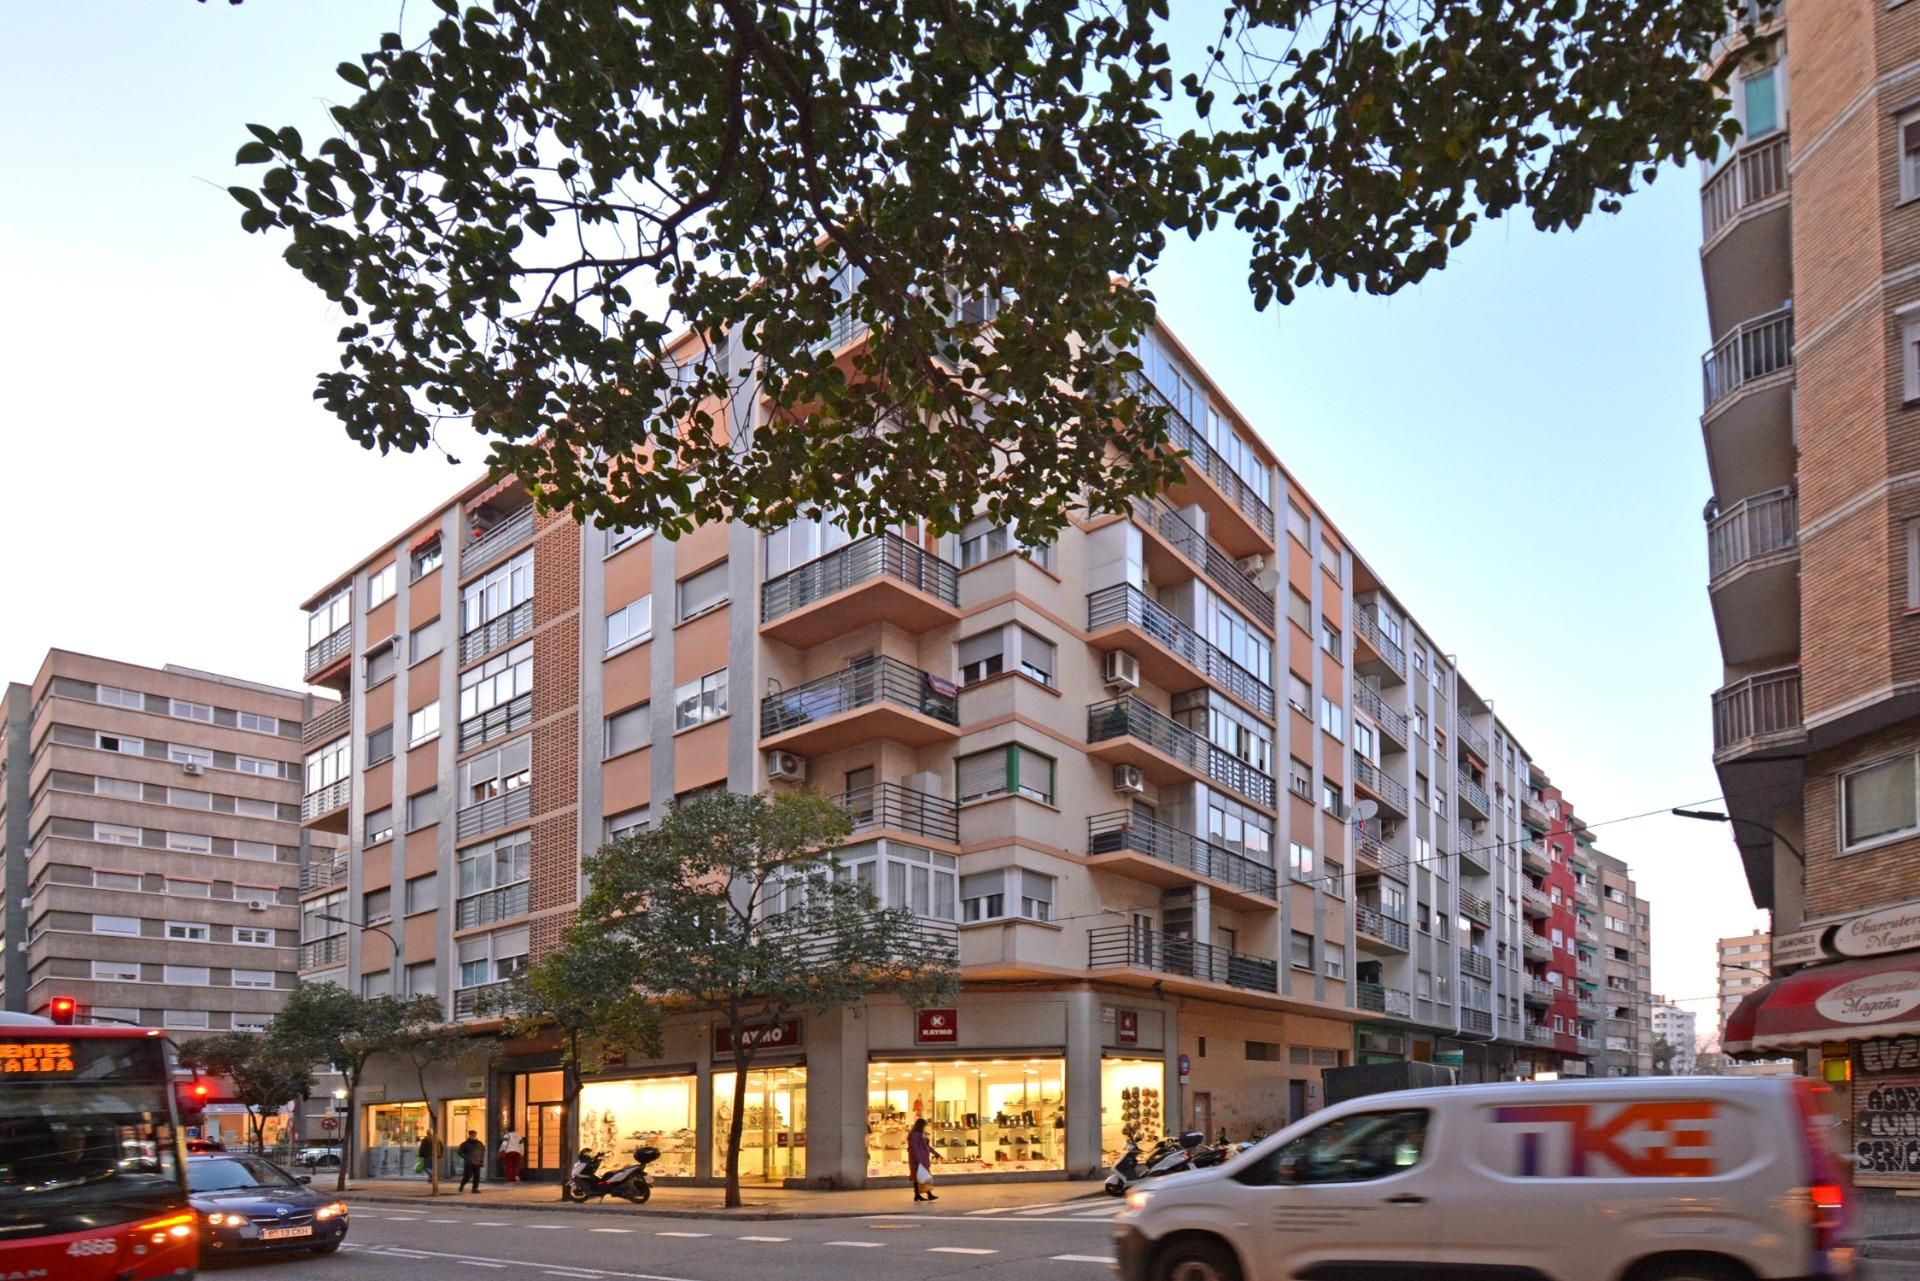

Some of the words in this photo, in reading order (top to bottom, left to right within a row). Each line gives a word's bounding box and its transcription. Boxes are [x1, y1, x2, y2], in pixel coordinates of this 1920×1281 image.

[1841, 995, 1901, 1017] Magaña
[731, 1027, 783, 1045] AYMO
[1871, 1113, 1920, 1136] LUN
